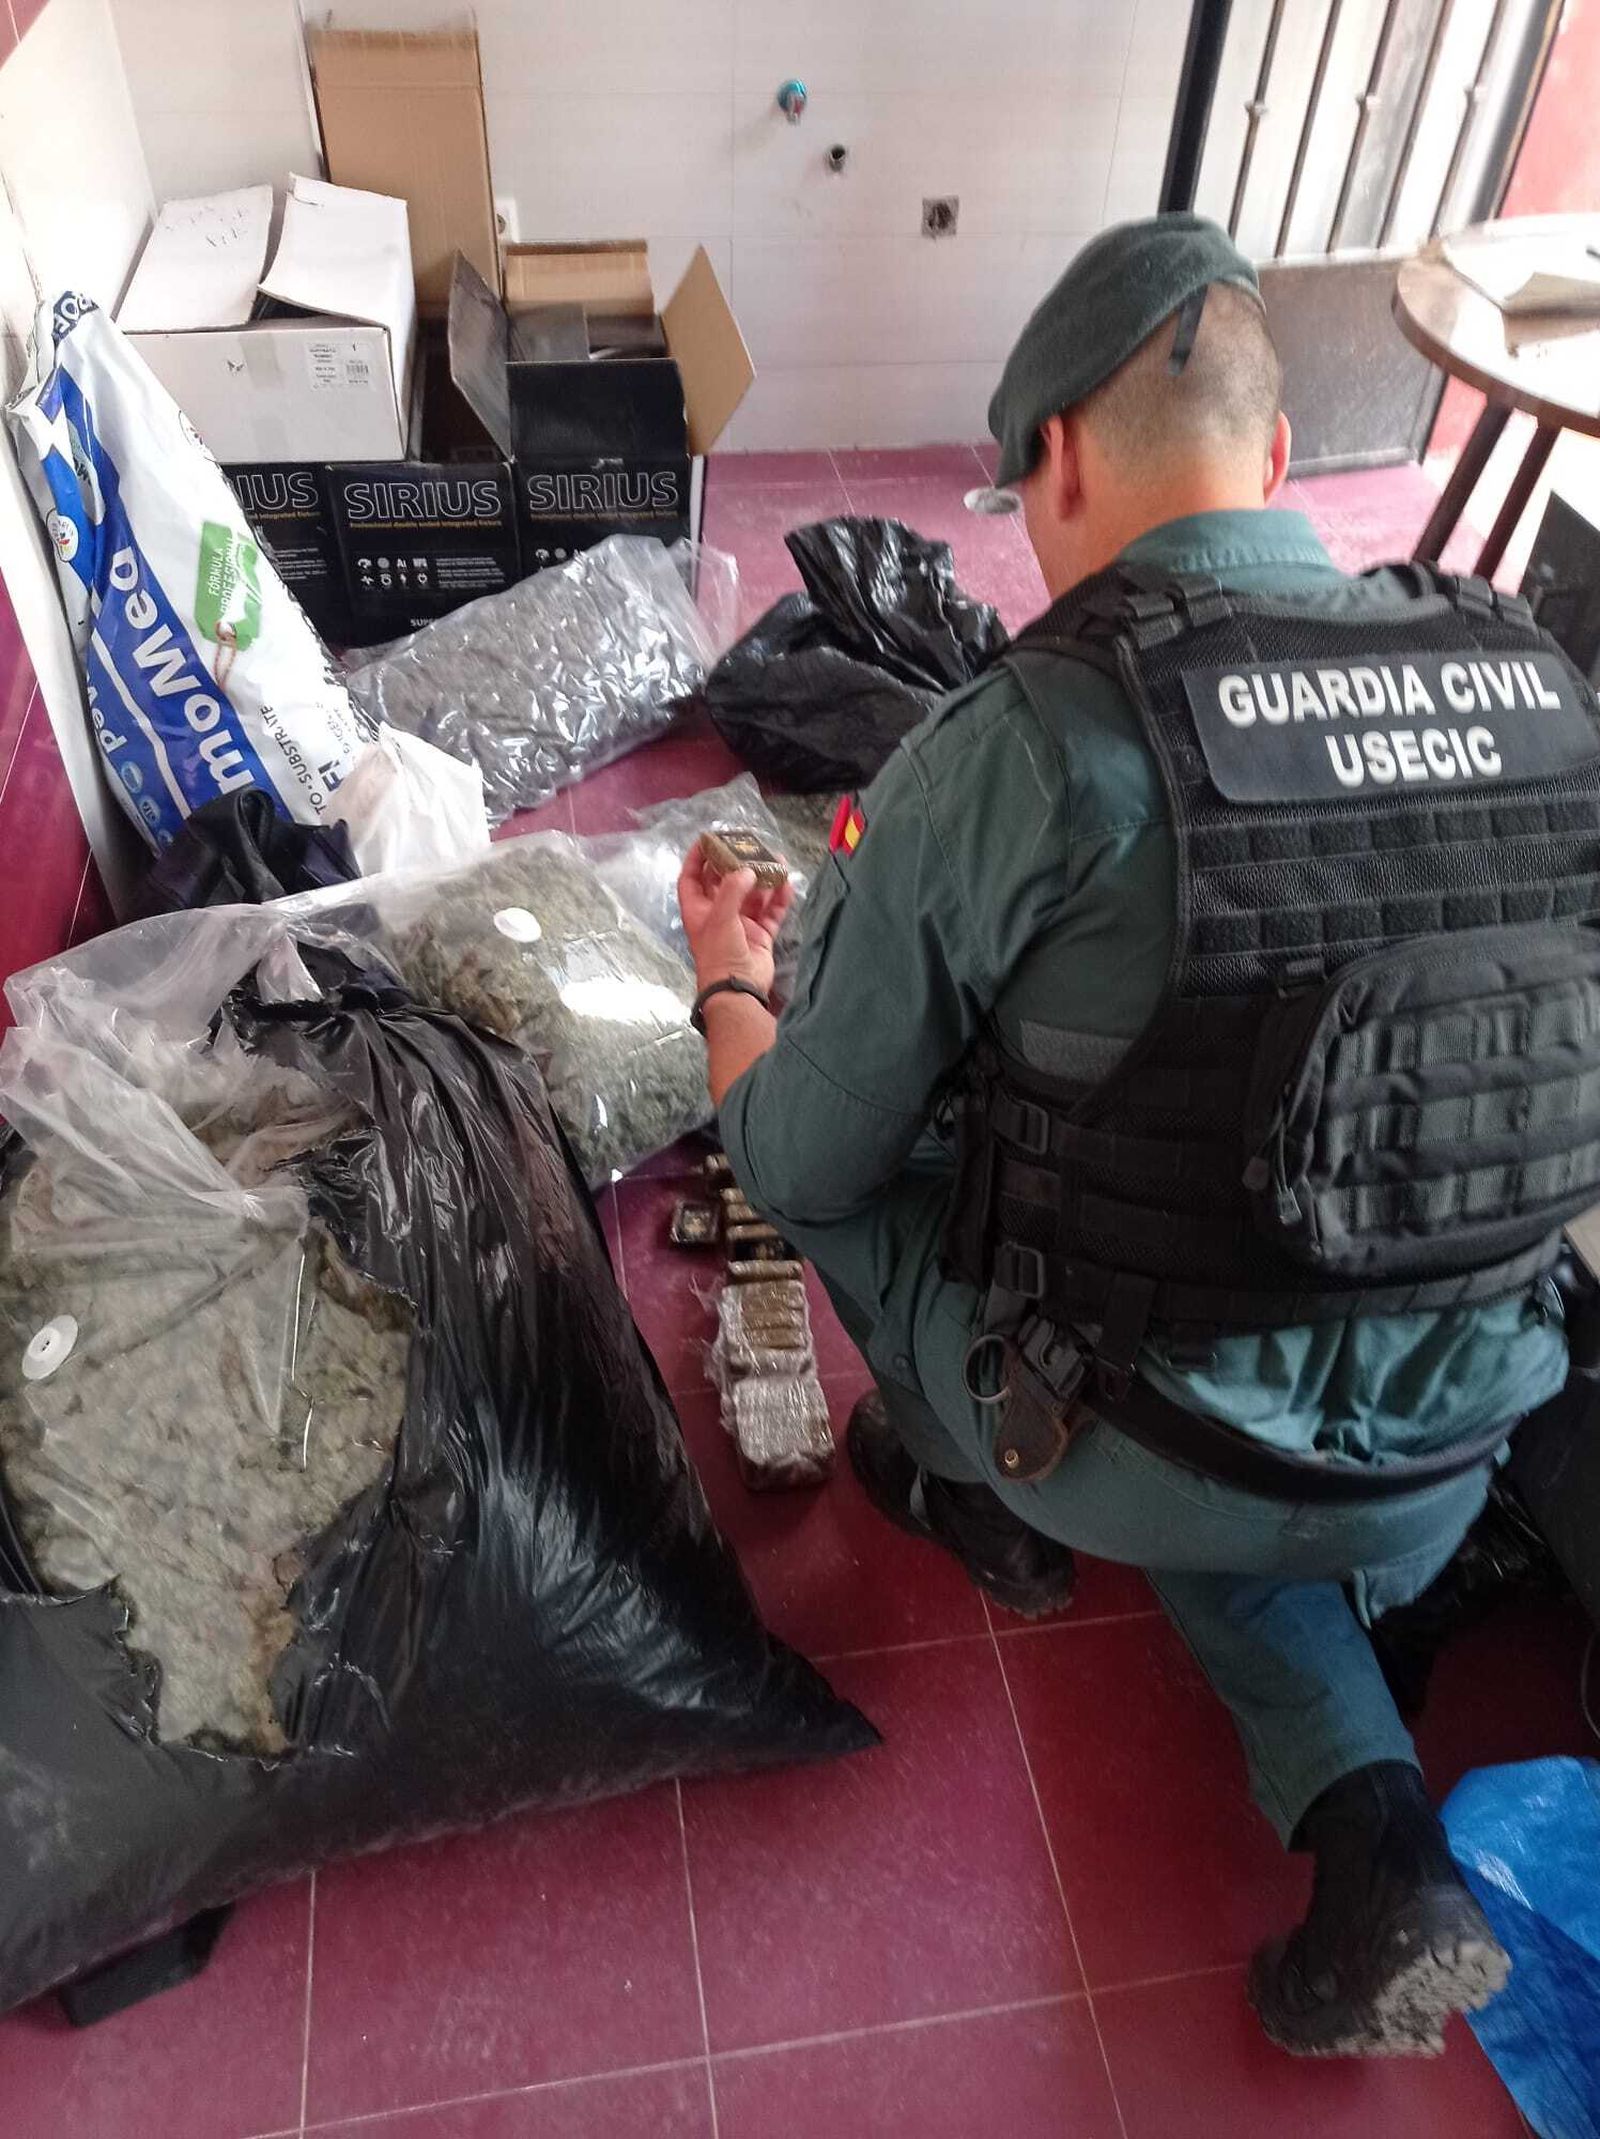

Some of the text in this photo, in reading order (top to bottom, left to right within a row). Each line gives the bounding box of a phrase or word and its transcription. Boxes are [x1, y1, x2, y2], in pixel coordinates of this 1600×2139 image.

[343, 480, 502, 520] SIRIUS
[527, 471, 680, 511] SIRIUS
[1218, 661, 1562, 728] GUARDIA CIVIL
[1325, 726, 1502, 788] USECIC
